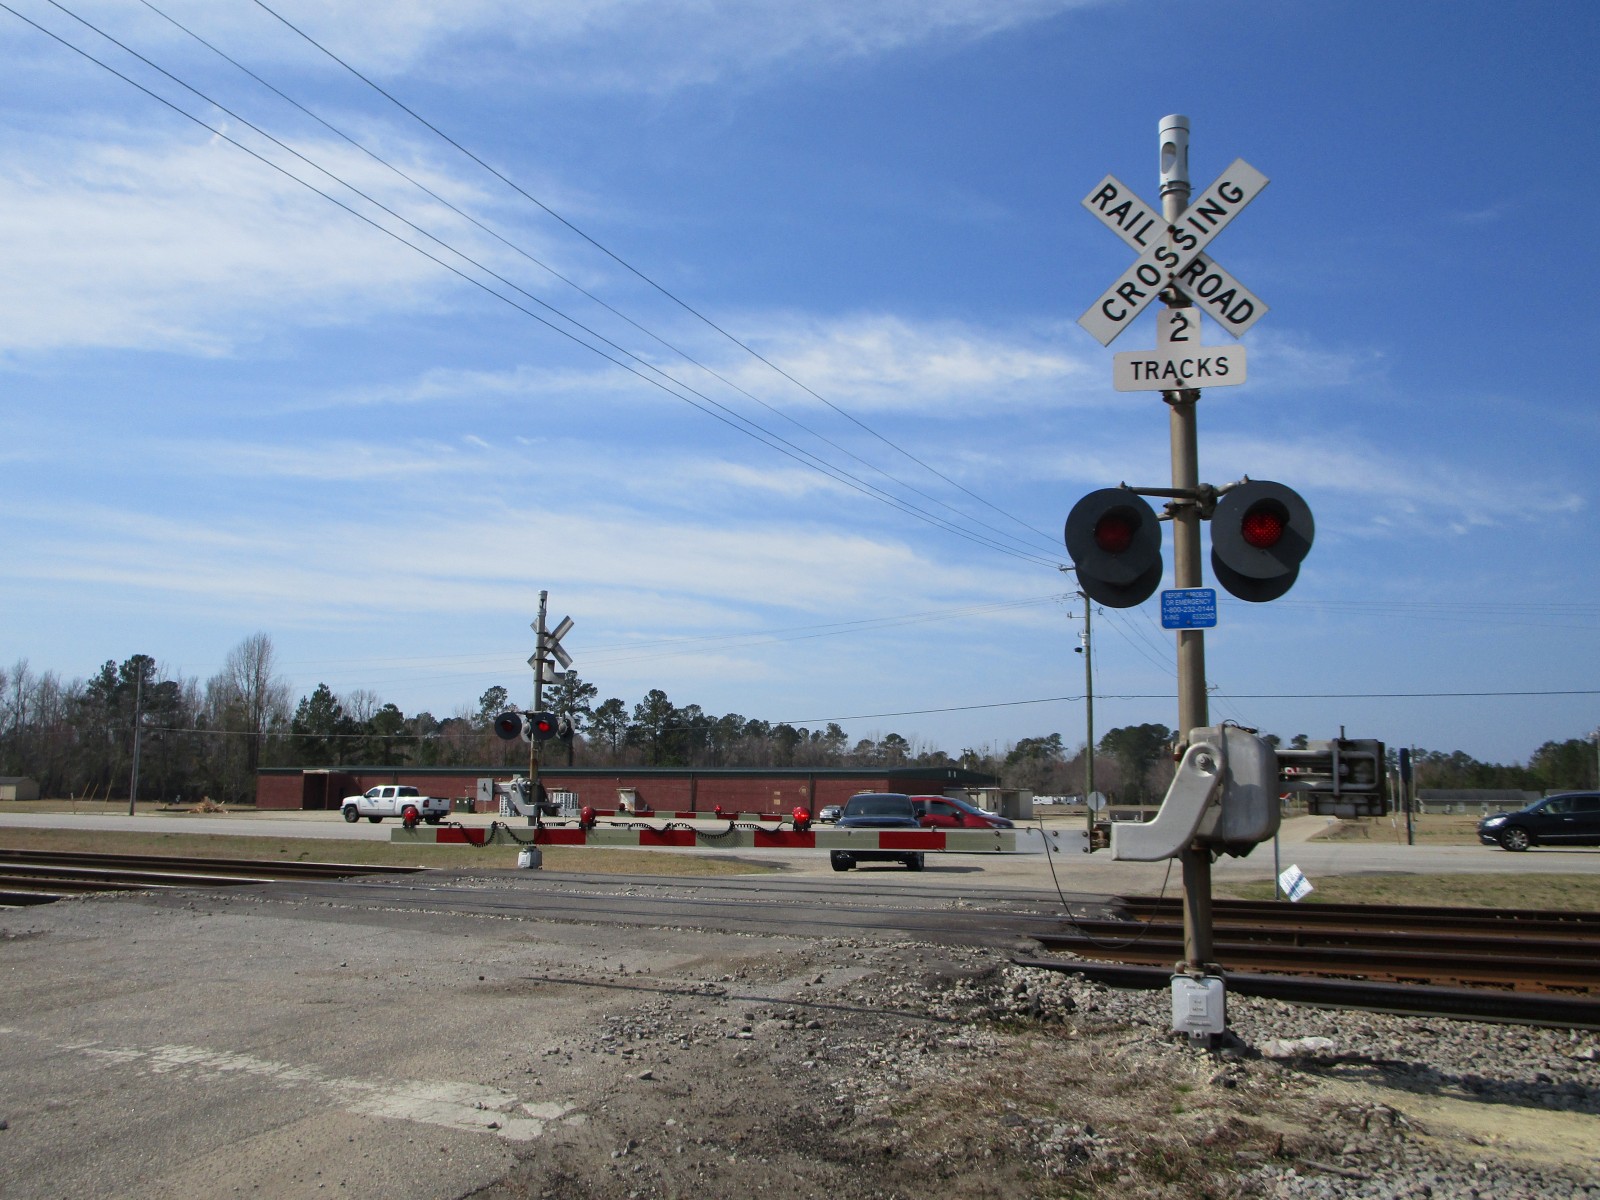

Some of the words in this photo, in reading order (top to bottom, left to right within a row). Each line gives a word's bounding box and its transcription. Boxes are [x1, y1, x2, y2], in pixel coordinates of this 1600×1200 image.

[1091, 183, 1155, 246] RAIL
[1179, 258, 1254, 324] ROAD
[1102, 181, 1244, 322] CROSSING
[1130, 356, 1229, 380] TRACKS
[1169, 317, 1189, 342] 2
